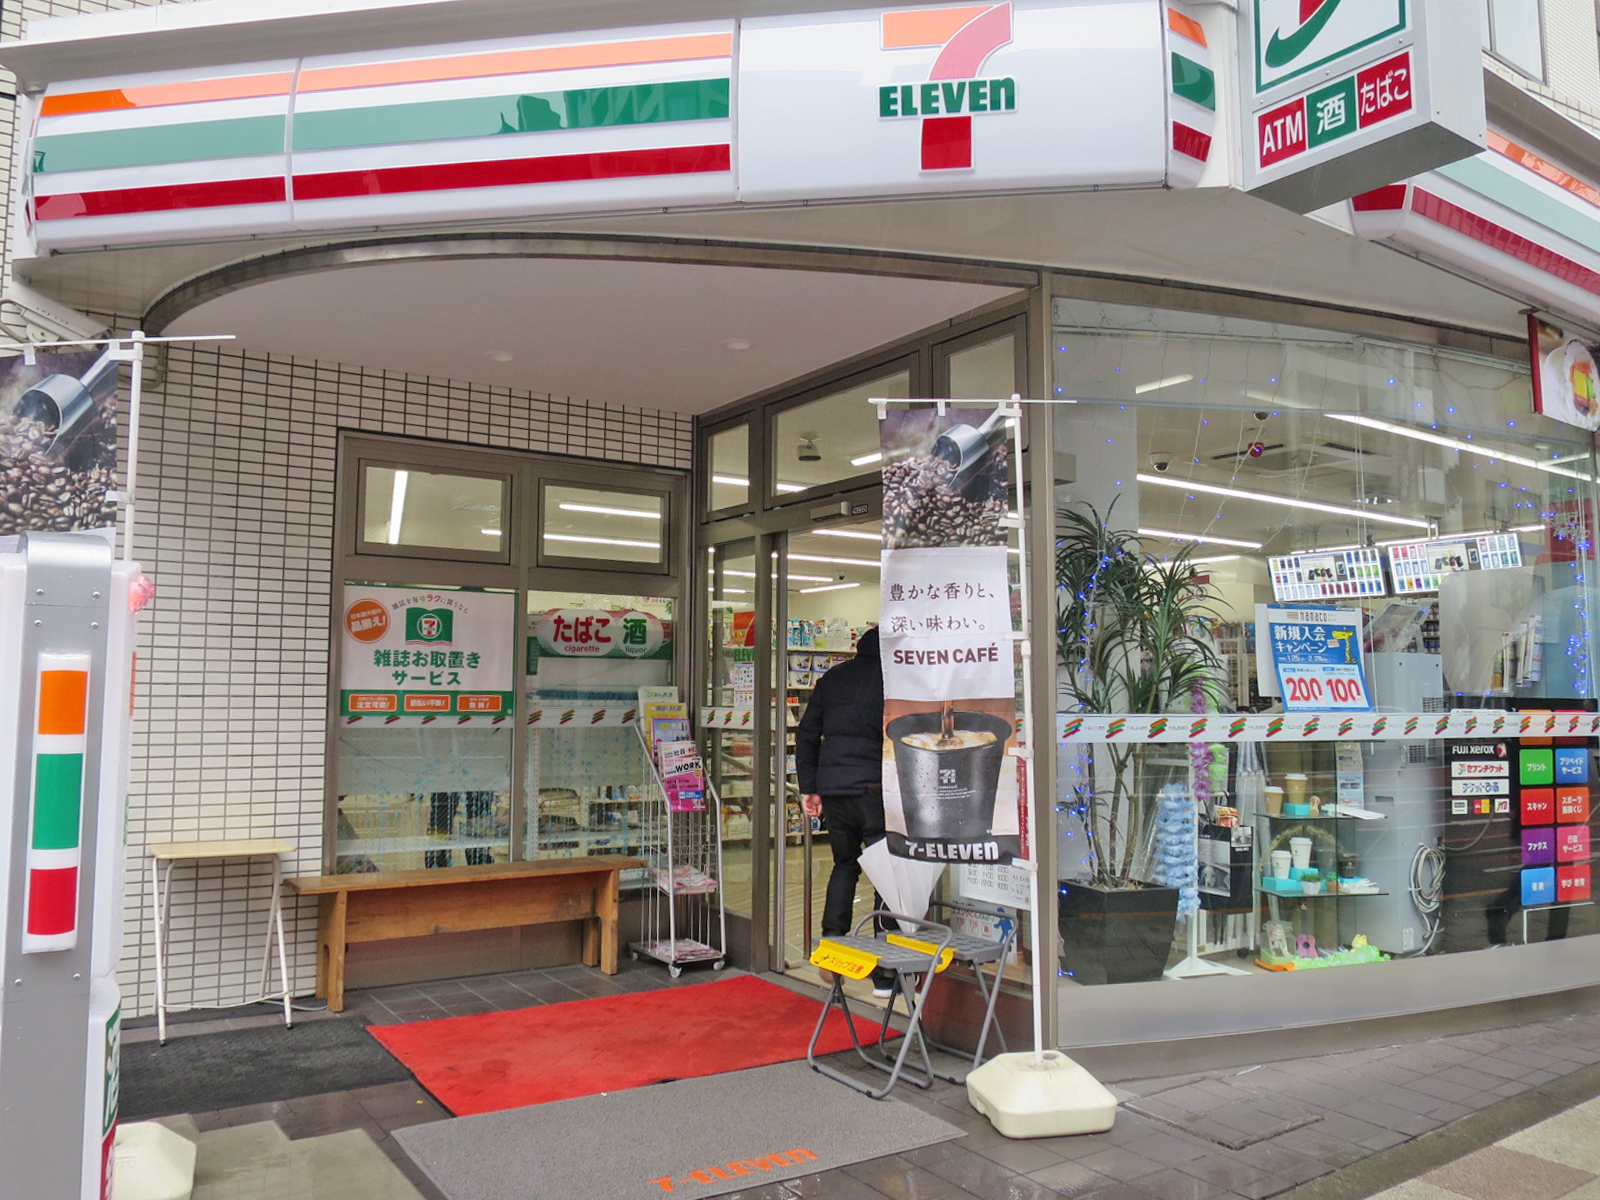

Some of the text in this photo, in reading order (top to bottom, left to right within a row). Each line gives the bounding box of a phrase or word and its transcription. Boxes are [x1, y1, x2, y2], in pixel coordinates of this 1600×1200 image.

[1262, 68, 1410, 156] ATM 酒 たばこ
[889, 582, 995, 602] 豊かな香りと、
[553, 615, 647, 645] たばこ 酒
[890, 615, 986, 633] 深い味わい。
[1274, 625, 1326, 641] 新規入会
[564, 644, 648, 654] cigarette liquor
[893, 641, 999, 665] SEVEN CAFÉ
[1275, 641, 1327, 653] キャンペーン
[374, 649, 481, 669] 雑誌お取置き
[392, 670, 461, 686] サービス
[1285, 677, 1362, 702] 200 100
[1452, 745, 1469, 755] FUJI
[675, 760, 702, 773] WORK
[1526, 763, 1547, 771] プリント
[1559, 757, 1584, 765] プリペイド
[1467, 764, 1504, 773] セブンチケット
[1561, 766, 1583, 775] サービス
[1561, 796, 1583, 804] スポーツ
[1526, 802, 1548, 811] スキャン
[1527, 842, 1548, 851] ファクス
[1562, 844, 1584, 853] サービス
[828, 956, 864, 975] スリップ注意
